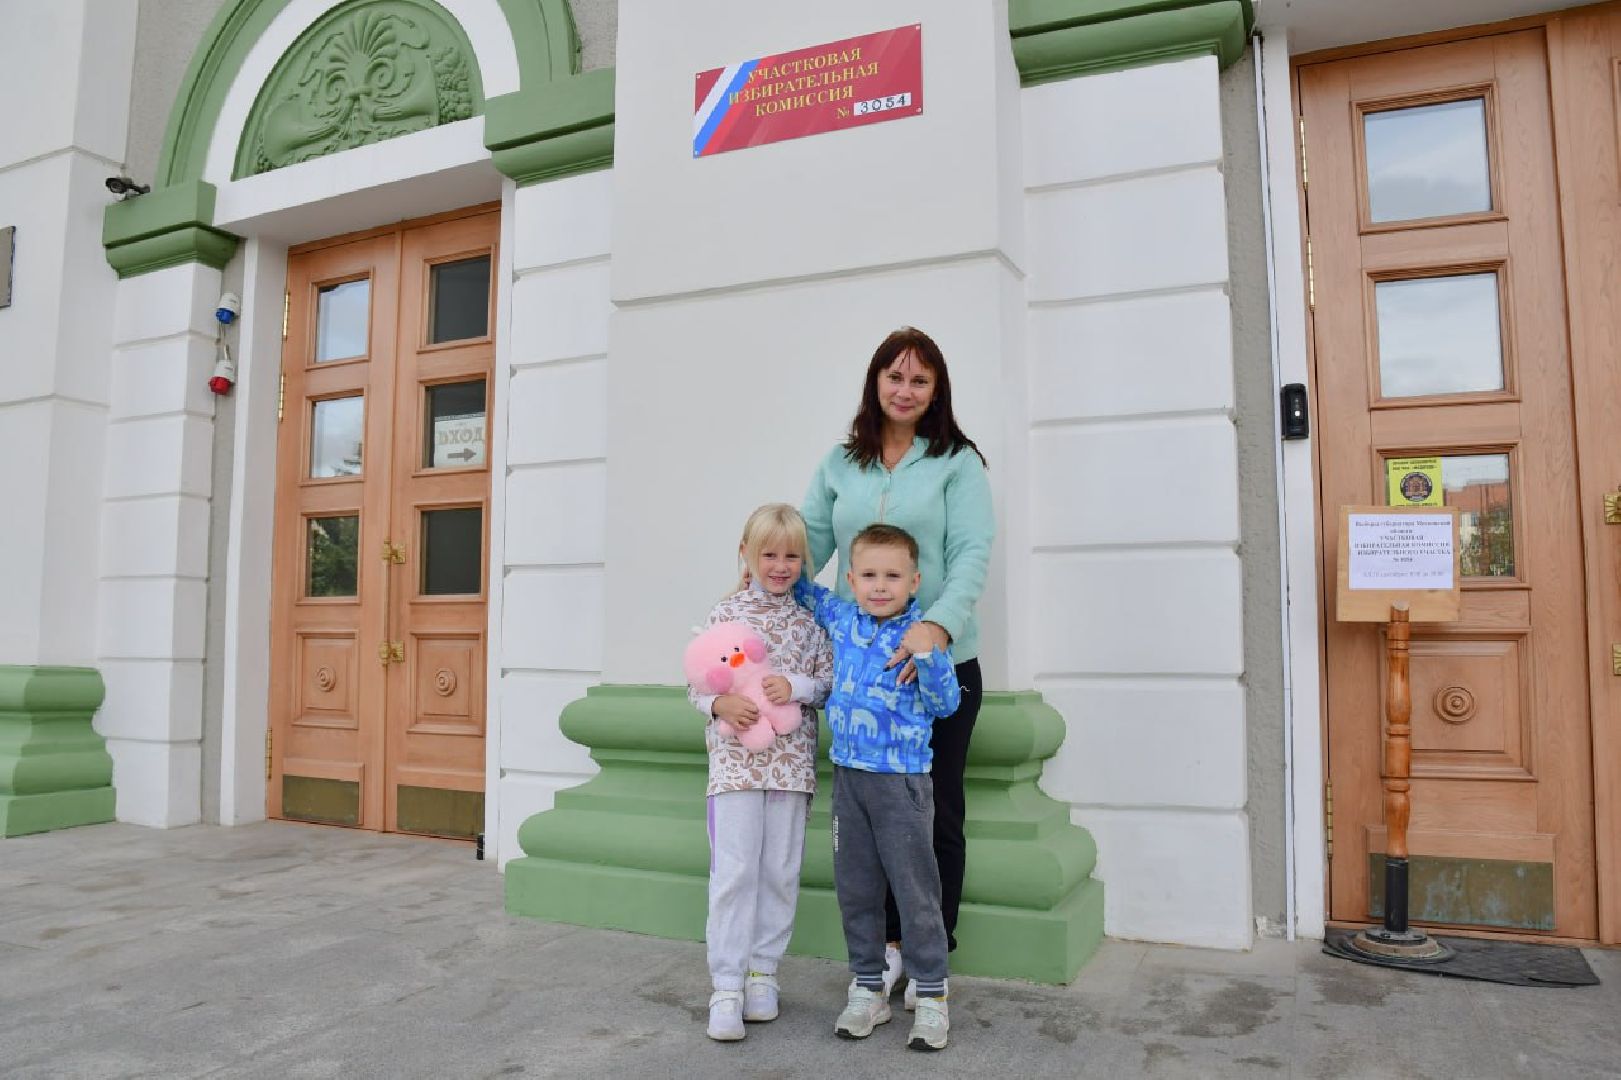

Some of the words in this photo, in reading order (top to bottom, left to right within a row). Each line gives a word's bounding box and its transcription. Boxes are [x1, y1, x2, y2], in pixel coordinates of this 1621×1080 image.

[748, 48, 861, 84] УЧАСТКОВАЯ
[729, 62, 878, 105] ИЗБИРАТЕЛЬНАЯ
[755, 85, 853, 117] КОМИССИЯ
[834, 106, 850, 120] №
[860, 93, 907, 114] 3054
